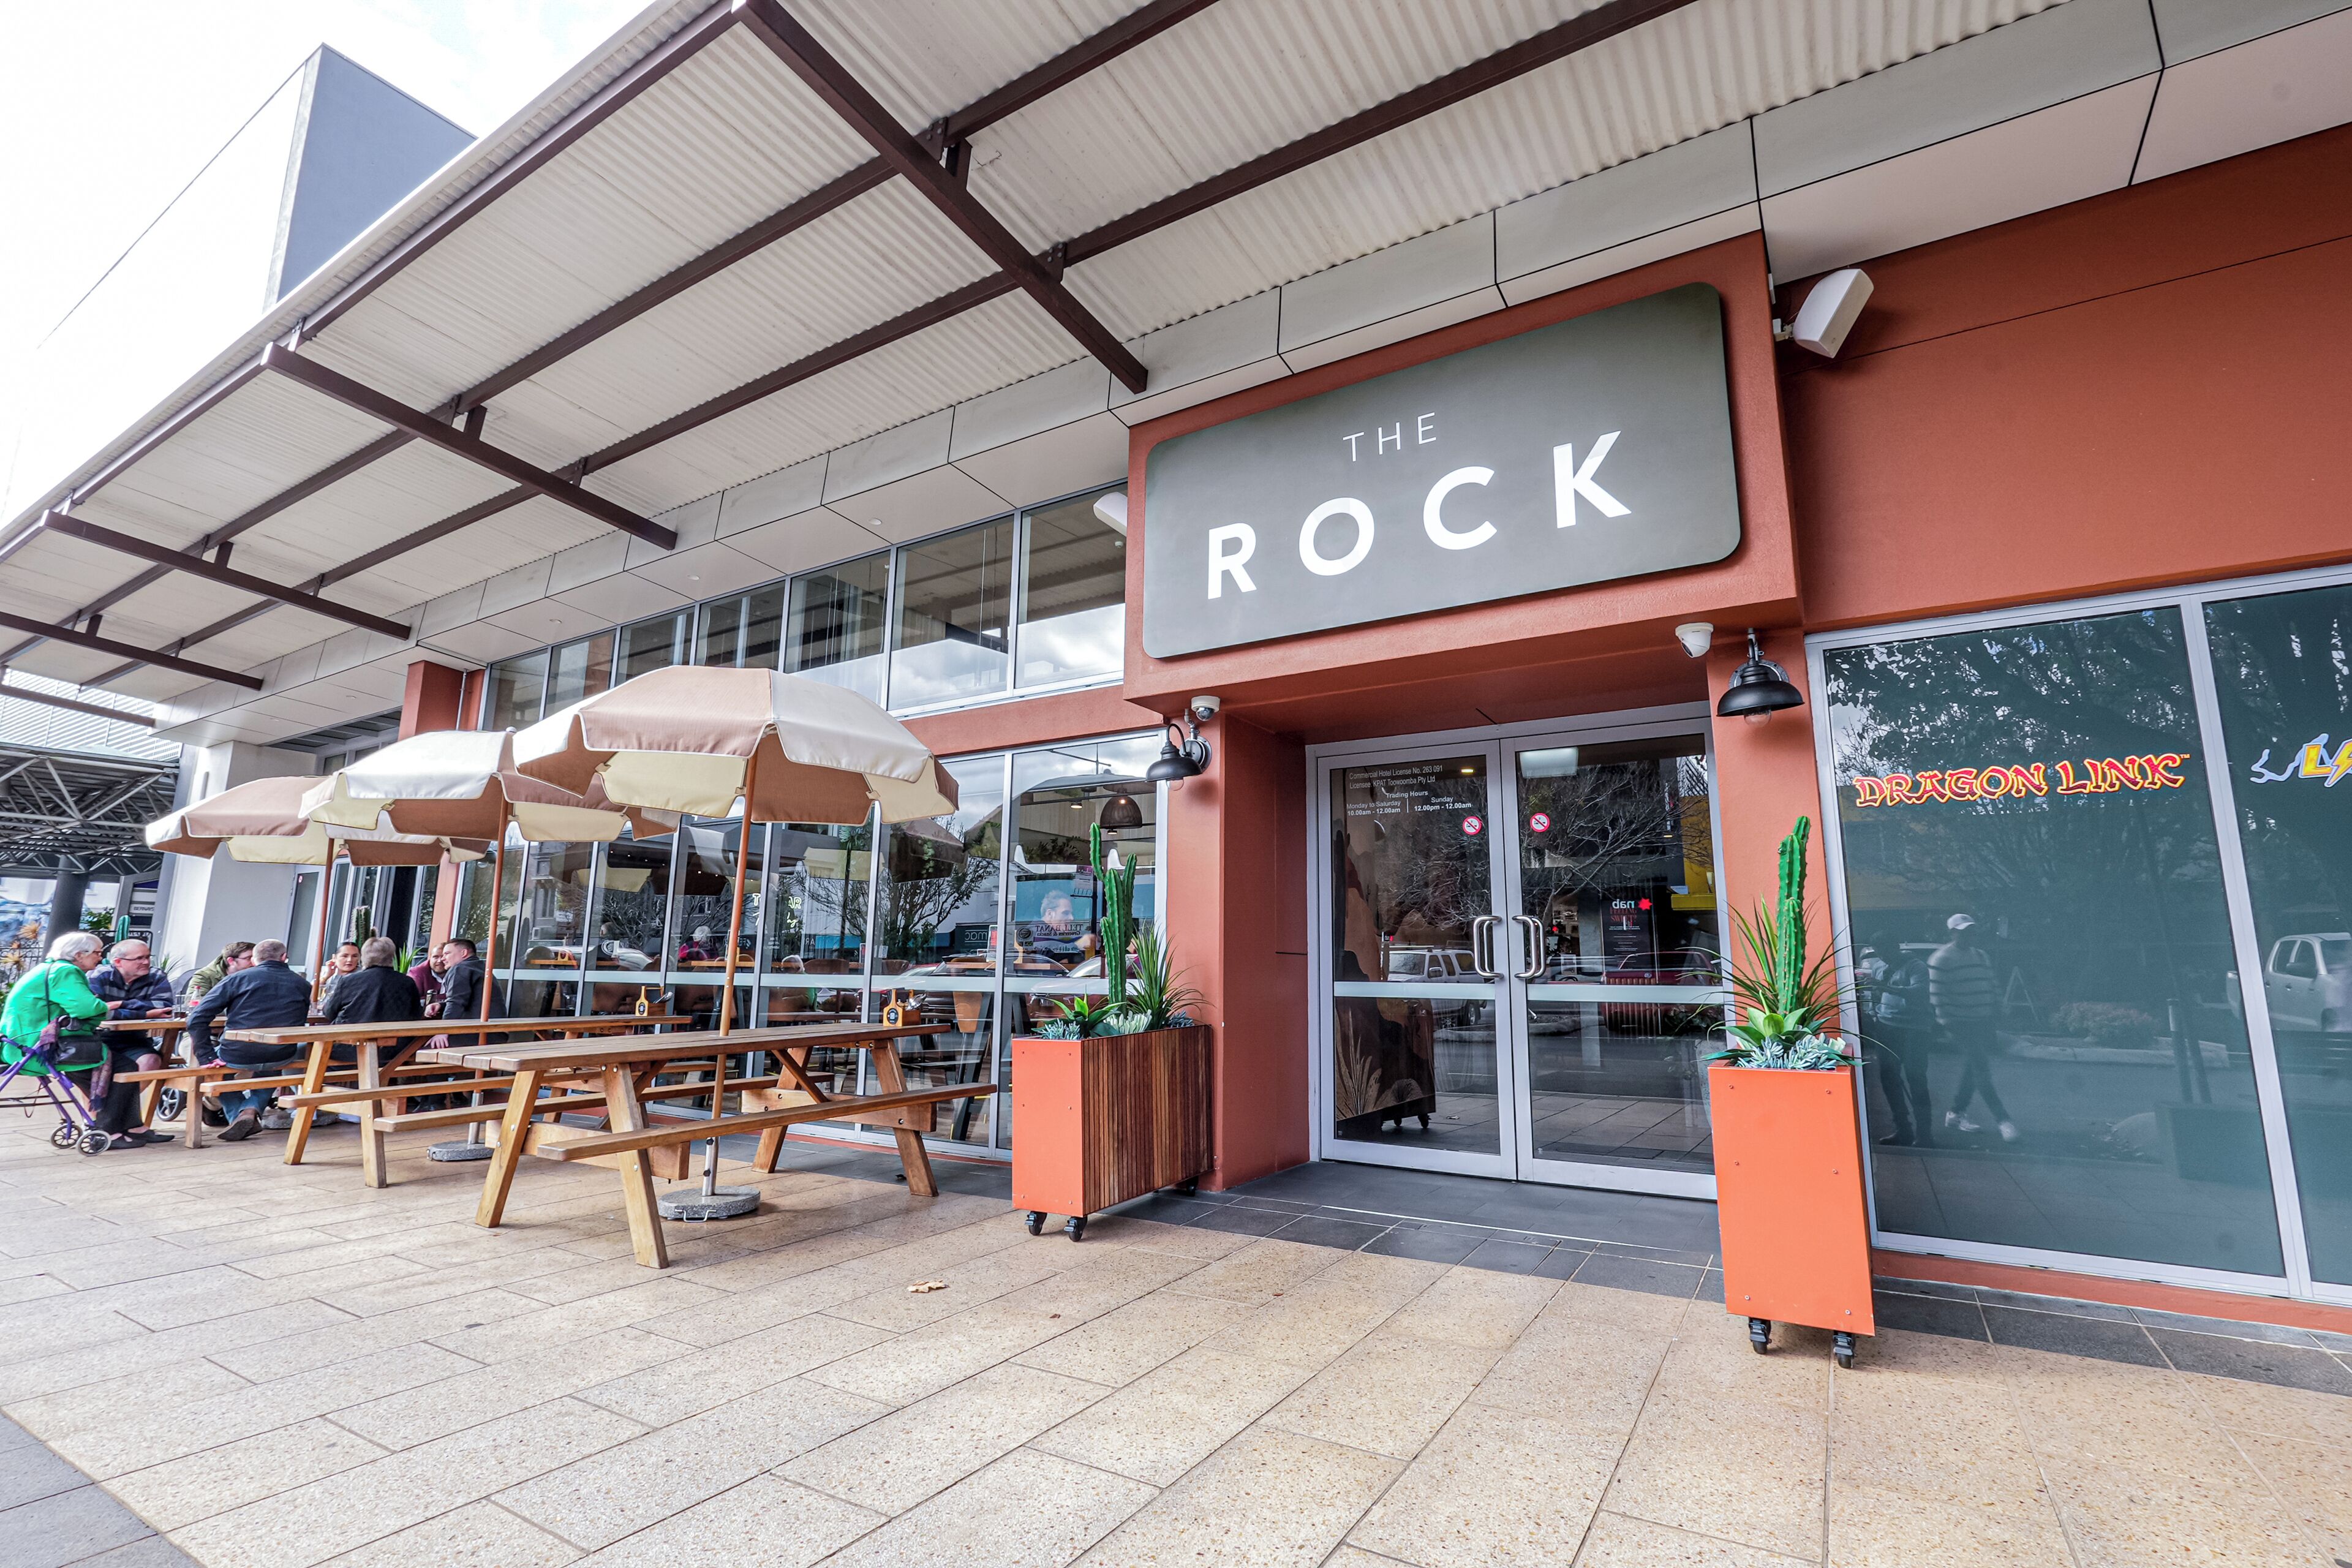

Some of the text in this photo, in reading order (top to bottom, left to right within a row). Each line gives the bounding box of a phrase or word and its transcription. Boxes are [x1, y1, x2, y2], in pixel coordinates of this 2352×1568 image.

[1343, 412, 1438, 462] THE
[1207, 430, 1632, 600] ROCK
[1853, 763, 2049, 807] DRAGON
[2055, 753, 2185, 794] LINK
